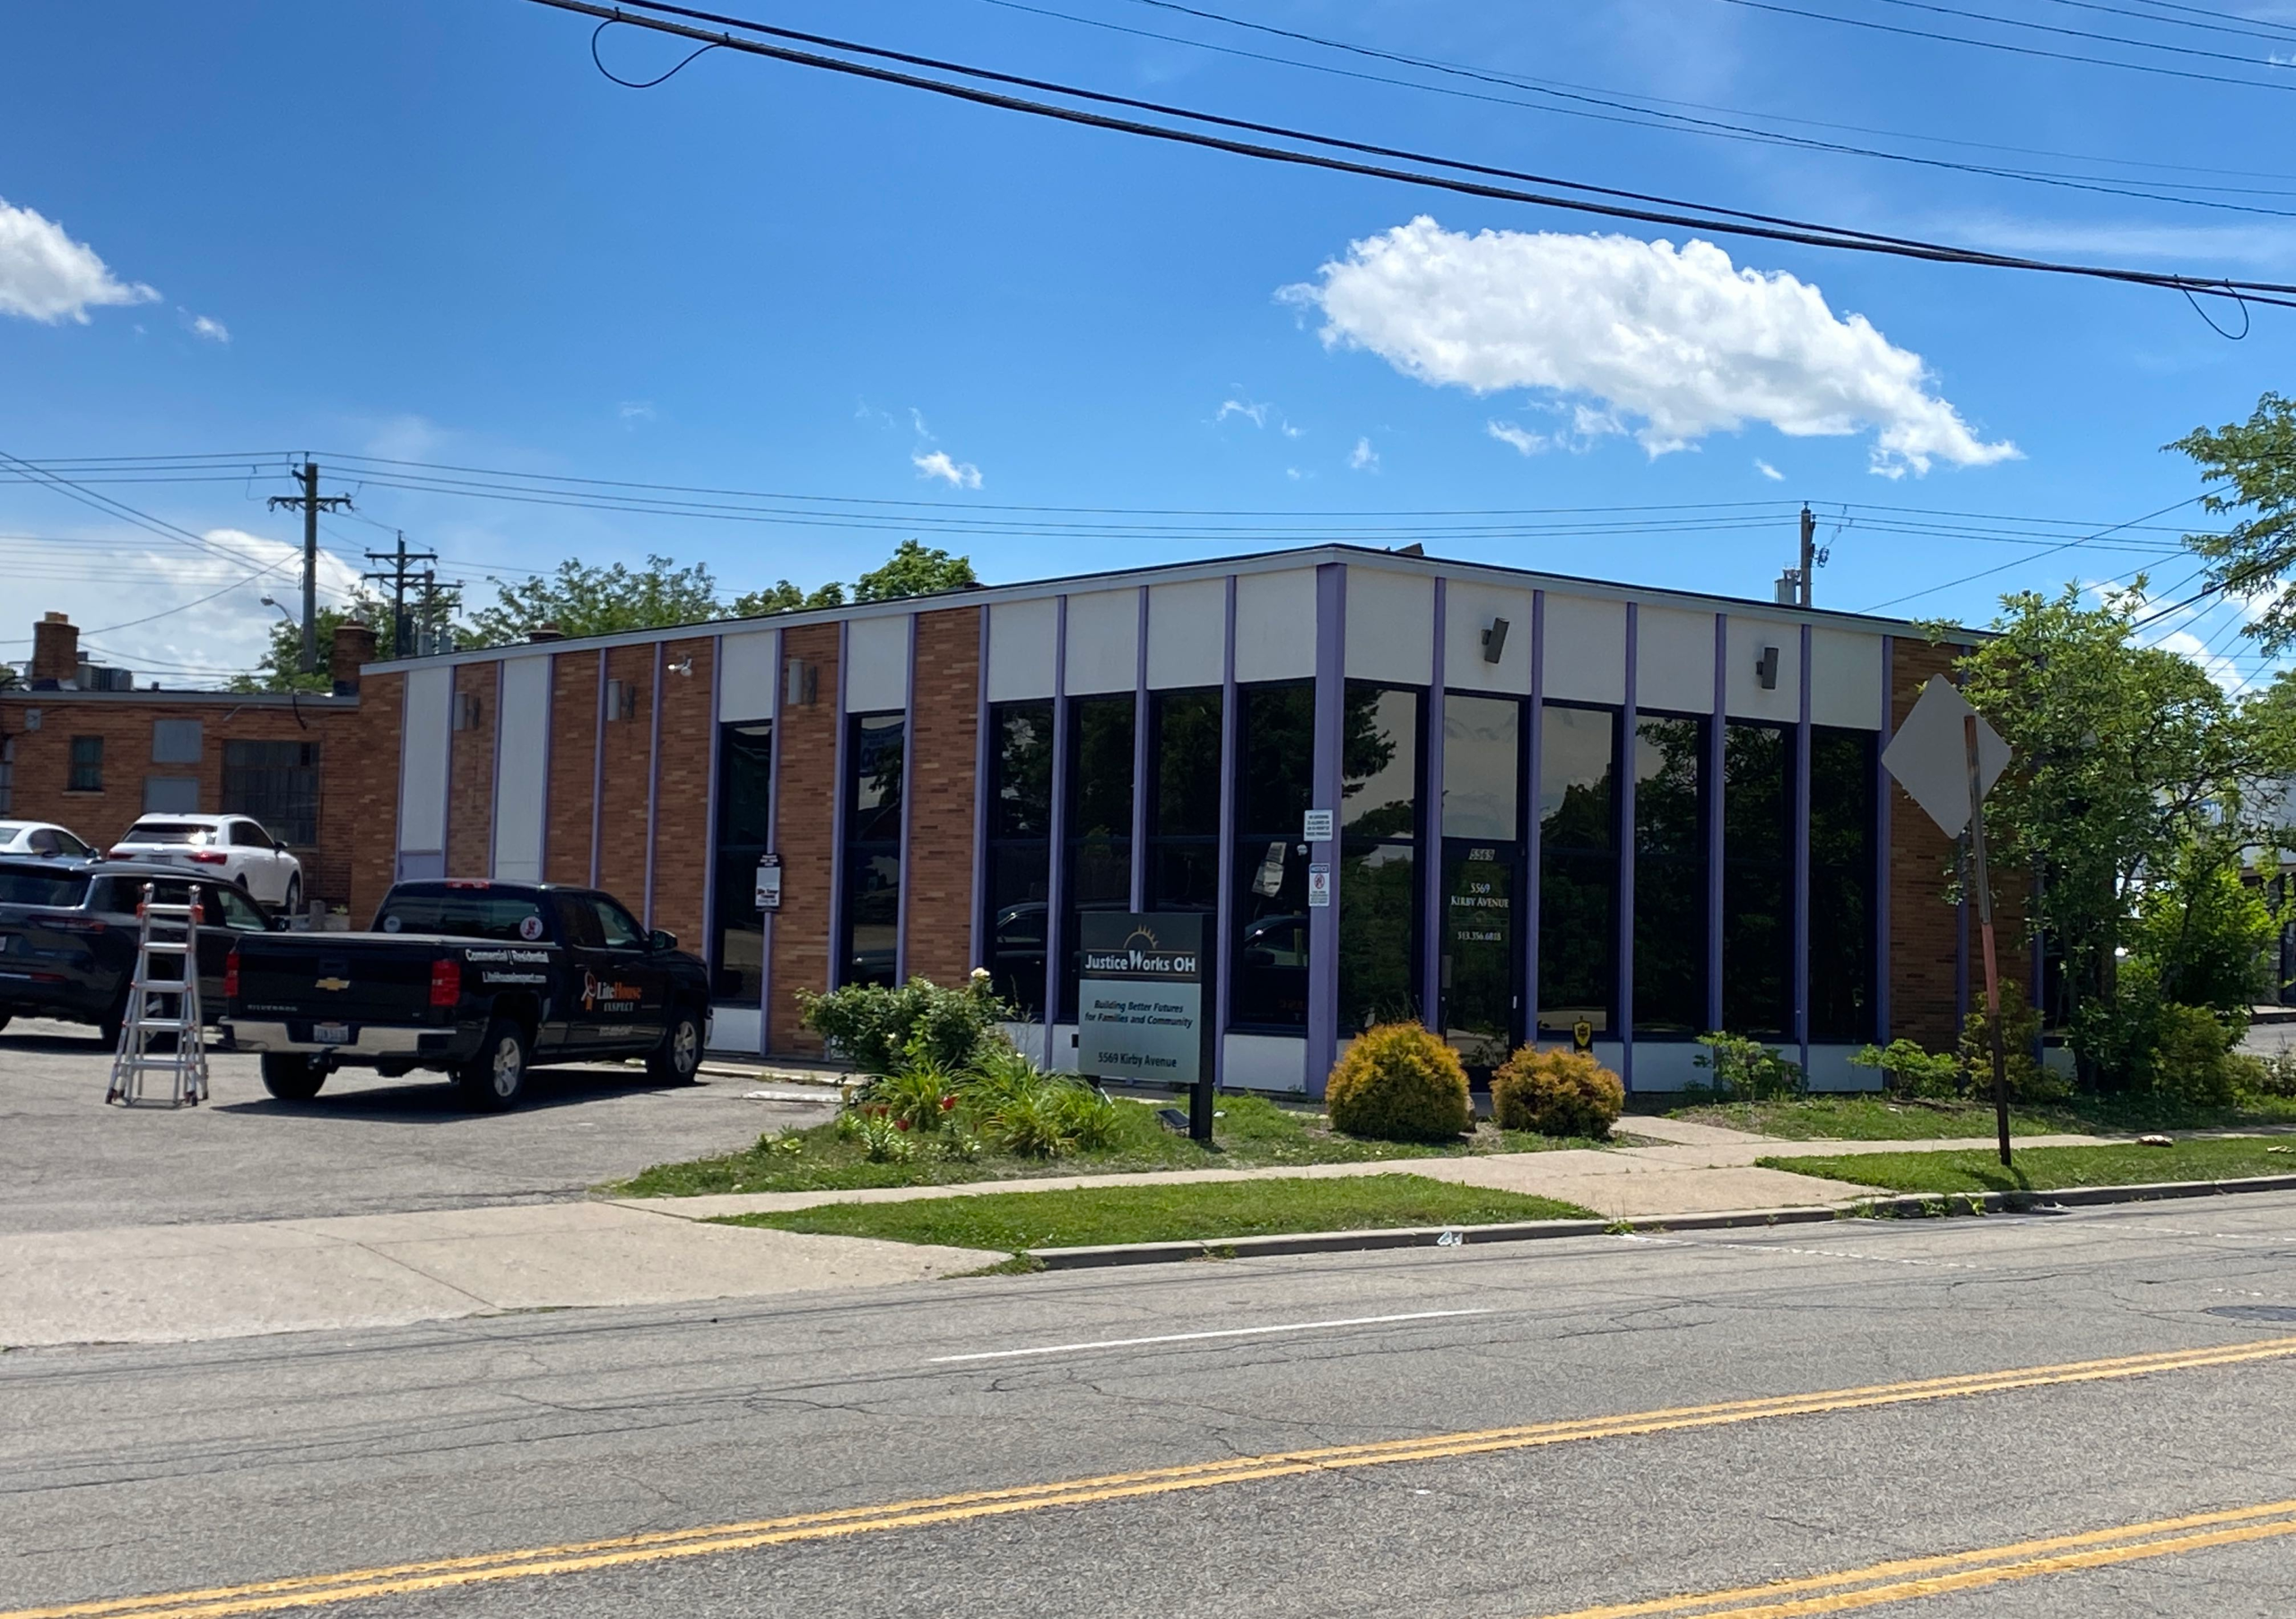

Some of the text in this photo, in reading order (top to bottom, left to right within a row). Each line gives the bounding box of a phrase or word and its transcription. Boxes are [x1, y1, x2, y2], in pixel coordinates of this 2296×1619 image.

[1470, 849, 1494, 860] 5569
[1470, 883, 1491, 893] 5569
[1451, 895, 1509, 908] KIRBY AVENUE
[465, 949, 508, 962] Commercial
[1173, 957, 1196, 972] OH
[597, 981, 641, 999] LiteHouse
[1094, 1000, 1184, 1014] Building Better Futures
[1084, 1012, 1194, 1029] for Families and Community
[1098, 1052, 1177, 1067] 5569 Kirby Avenue
